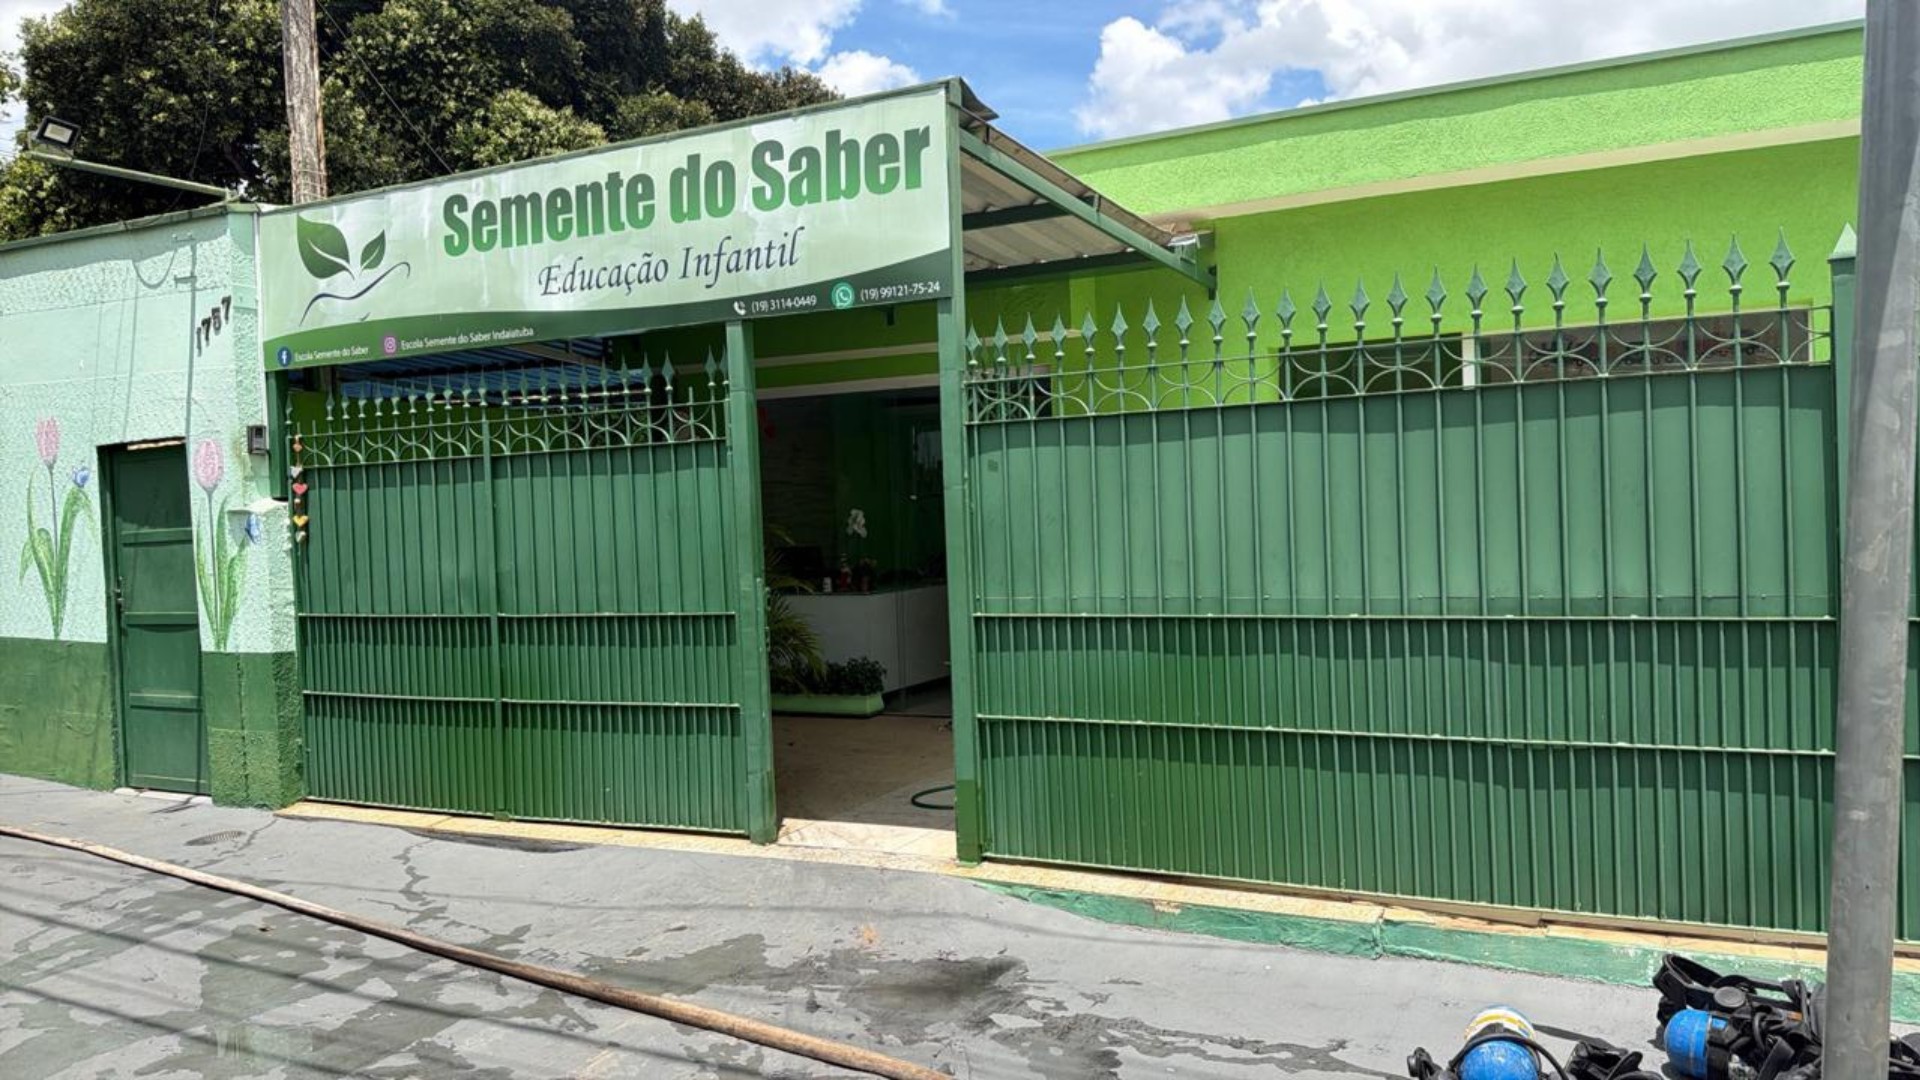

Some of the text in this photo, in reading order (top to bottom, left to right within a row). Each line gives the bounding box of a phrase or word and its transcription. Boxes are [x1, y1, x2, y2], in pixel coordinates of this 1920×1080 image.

[443, 125, 931, 257] Semente do Saber
[538, 226, 805, 296] Educação Infantil
[424, 335, 456, 348] Semente
[458, 333, 468, 344] do
[470, 331, 491, 343] Saber
